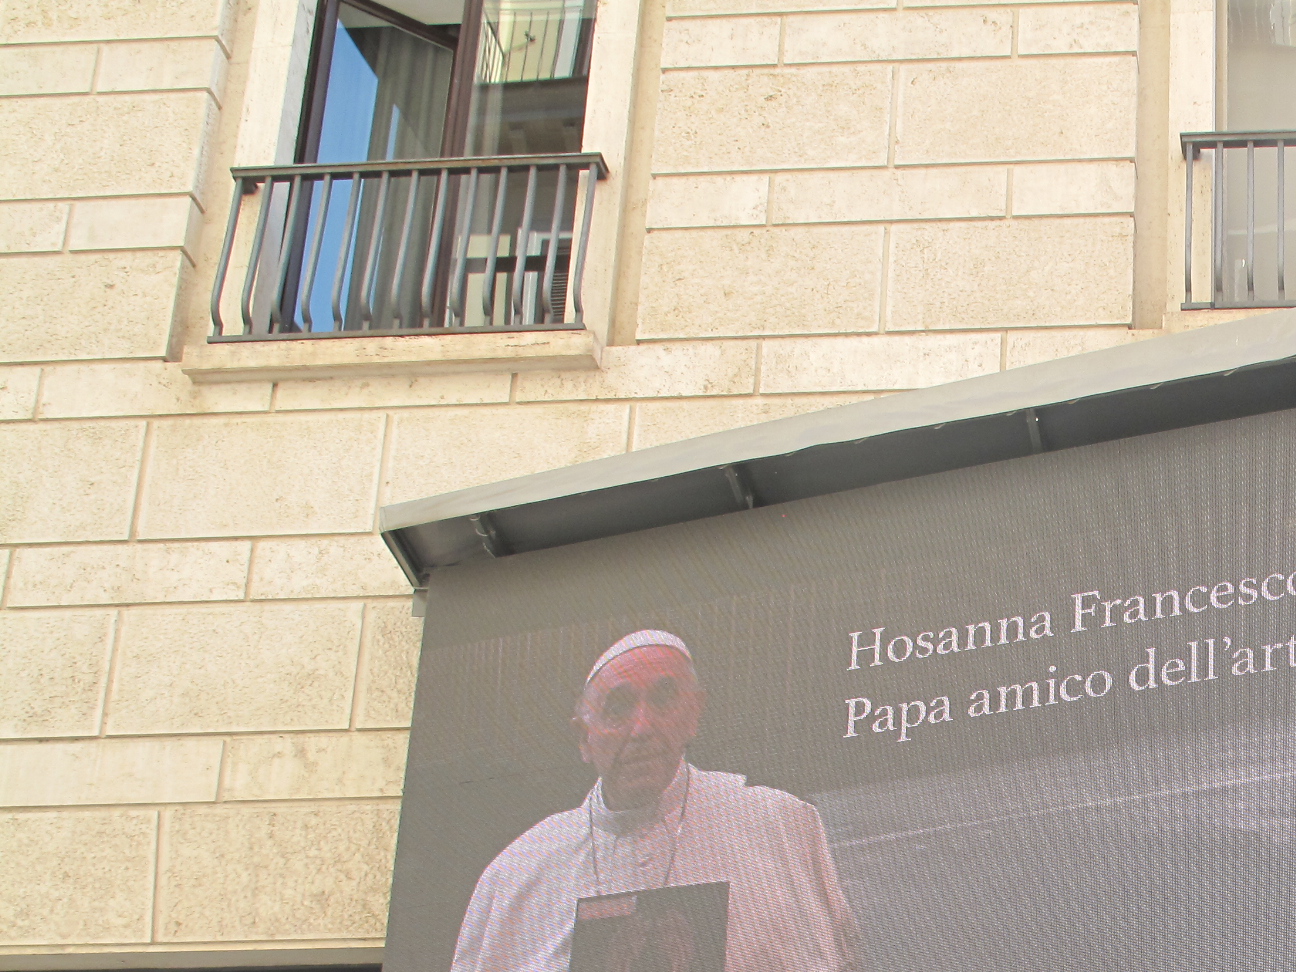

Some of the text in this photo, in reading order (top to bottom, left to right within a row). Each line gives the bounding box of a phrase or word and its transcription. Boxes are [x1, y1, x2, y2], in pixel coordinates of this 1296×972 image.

[846, 608, 1054, 670] Hosanna
[843, 694, 953, 742] Papa
[967, 665, 1112, 717] amico
